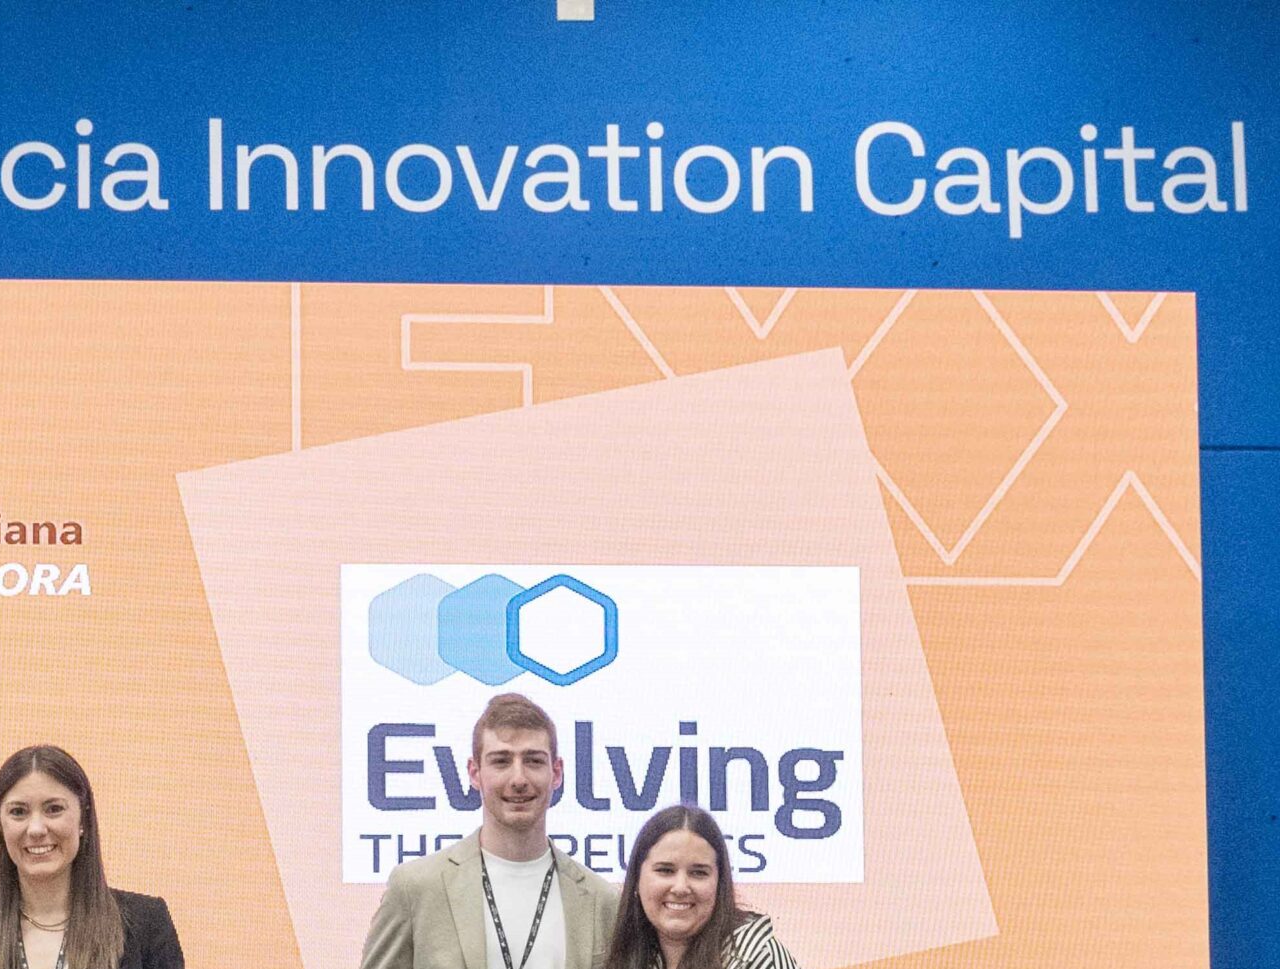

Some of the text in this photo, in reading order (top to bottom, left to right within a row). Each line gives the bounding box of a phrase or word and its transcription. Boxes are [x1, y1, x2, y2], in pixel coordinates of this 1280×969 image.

[207, 117, 815, 215] Innovation
[855, 119, 1249, 239] Capital
[366, 720, 844, 840] Evlving
